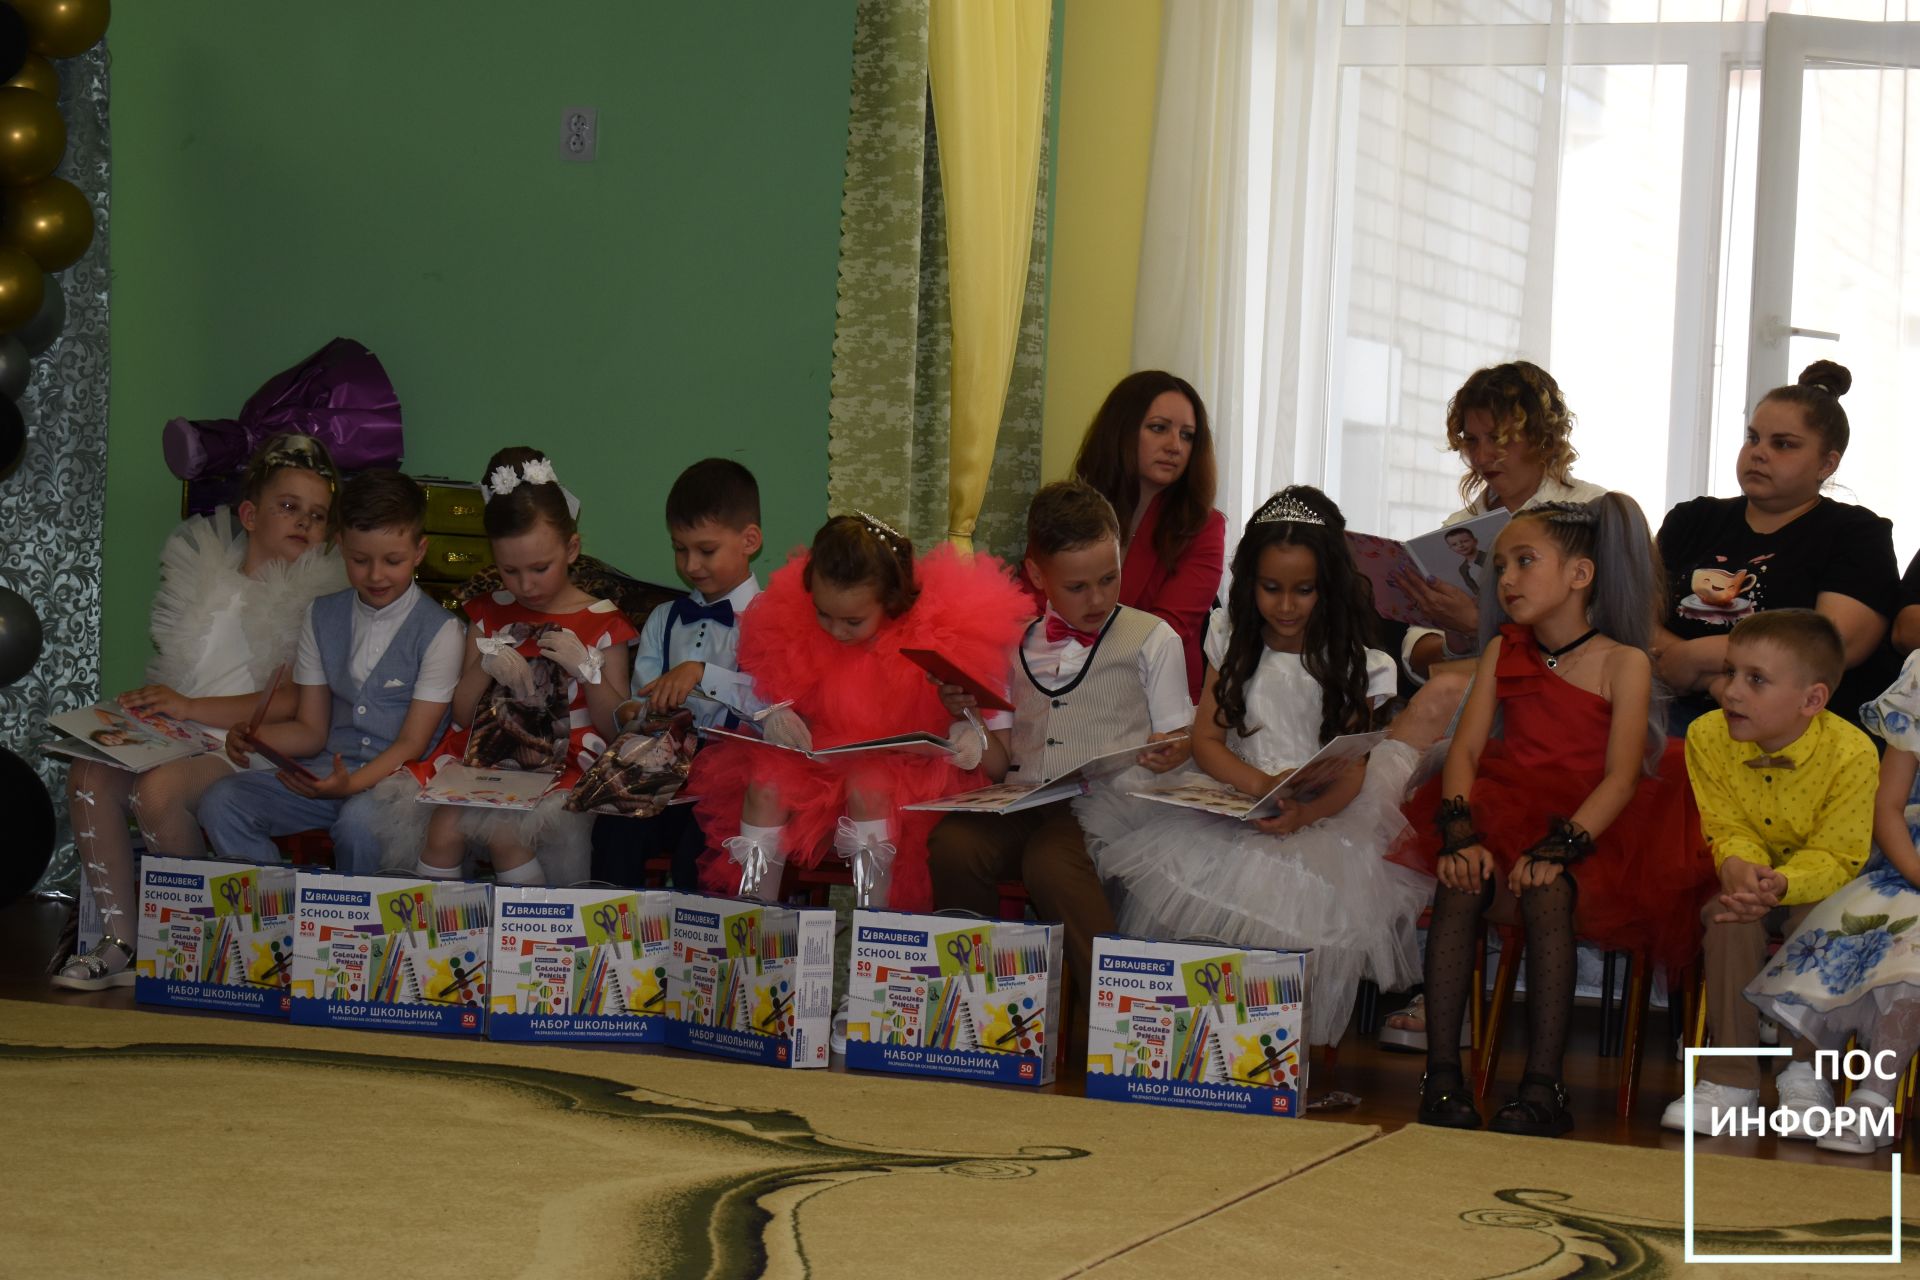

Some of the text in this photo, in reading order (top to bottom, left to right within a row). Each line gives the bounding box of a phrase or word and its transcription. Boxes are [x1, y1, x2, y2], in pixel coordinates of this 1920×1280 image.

[158, 874, 198, 886] BRAUBERG
[145, 890, 203, 903] SCHOOL BOX
[316, 892, 362, 903] BRAUBERG
[145, 903, 156, 912] 50
[517, 905, 565, 916] BRAUBERG
[301, 909, 370, 920] SCHOOL BOX
[684, 913, 714, 925] BRAUBERG
[300, 922, 314, 930] 50
[502, 923, 572, 932] SCHOOL BOX
[502, 936, 516, 945] 50
[674, 928, 718, 943] SCHOOL BOX
[873, 932, 920, 943] BRAUBERG
[674, 942, 682, 951] 50
[857, 948, 927, 961] SCHOOL BOX
[857, 961, 871, 970] 50
[1115, 960, 1165, 972] BRAUBERG
[1099, 977, 1173, 991] SCHOOL BOX
[167, 985, 200, 996] НАБОР
[203, 988, 264, 1002] ШКОЛЬНИКА
[1098, 991, 1113, 1001] 50
[328, 1005, 442, 1020] НАБОР ШКОЛЬНИКА
[530, 1020, 647, 1030] НАБОР ШКОЛЬНИКА
[689, 1028, 714, 1040] НАБОР
[716, 1033, 764, 1051] ШКОЛЬНИКА
[778, 1047, 786, 1055] 50
[817, 1047, 823, 1058] 50
[884, 1049, 999, 1069] НАБОР ШКОЛЬНИКА
[1128, 1082, 1251, 1103] НАБОР ШКОЛЬНИКА
[1275, 1098, 1286, 1106] 50
